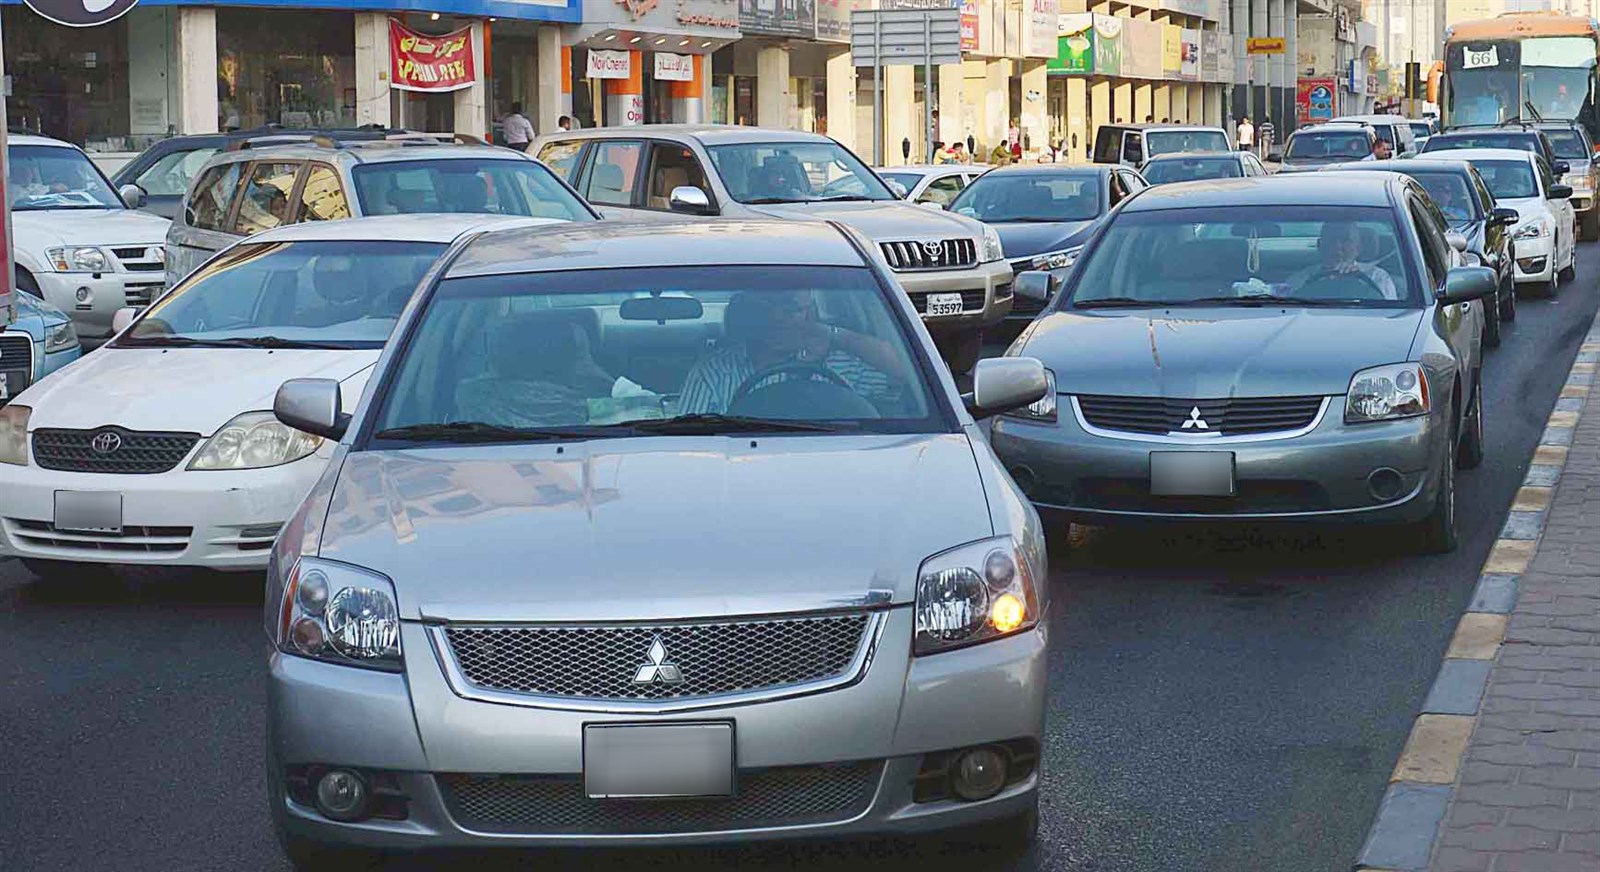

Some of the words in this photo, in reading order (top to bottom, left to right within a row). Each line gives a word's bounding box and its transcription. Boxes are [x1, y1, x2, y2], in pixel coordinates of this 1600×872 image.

[592, 56, 605, 71] Now
[606, 56, 628, 71] Opened
[1471, 52, 1490, 65] 66
[627, 110, 643, 123] Op
[932, 302, 962, 314] 53597
